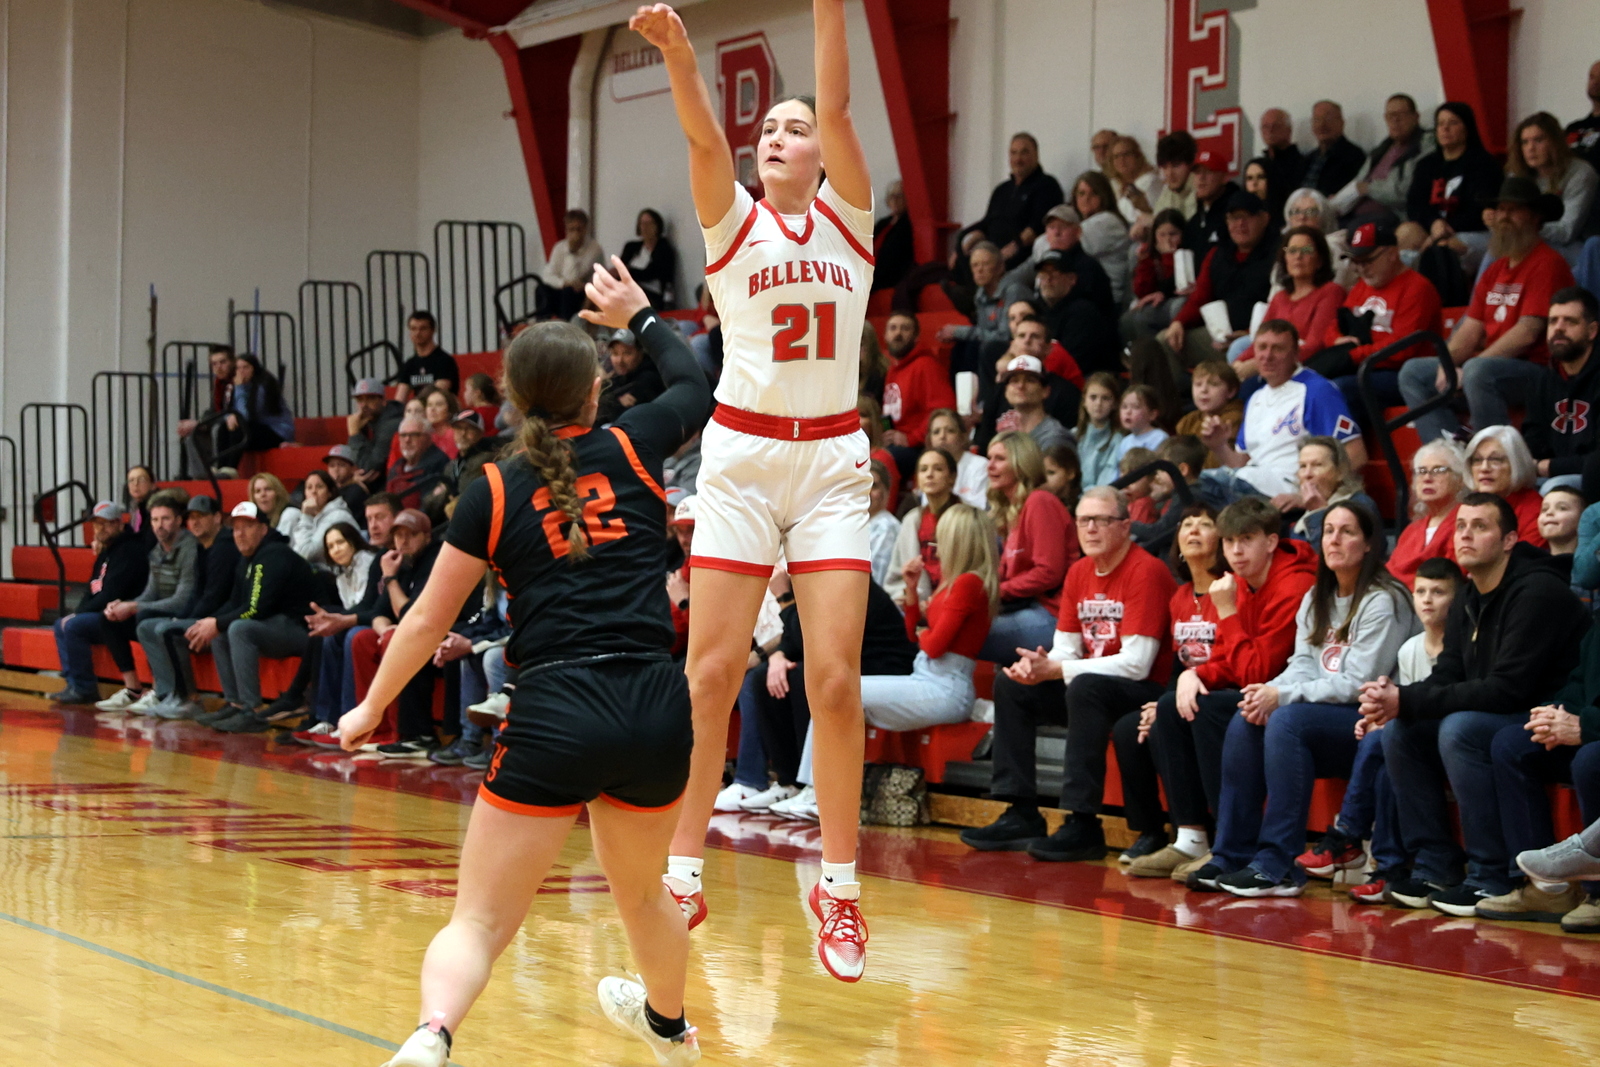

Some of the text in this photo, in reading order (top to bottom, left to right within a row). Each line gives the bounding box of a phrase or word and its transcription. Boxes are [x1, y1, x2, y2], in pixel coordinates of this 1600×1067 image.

[748, 260, 853, 299] BELLEVUE
[771, 301, 836, 363] 21
[793, 421, 800, 439] B
